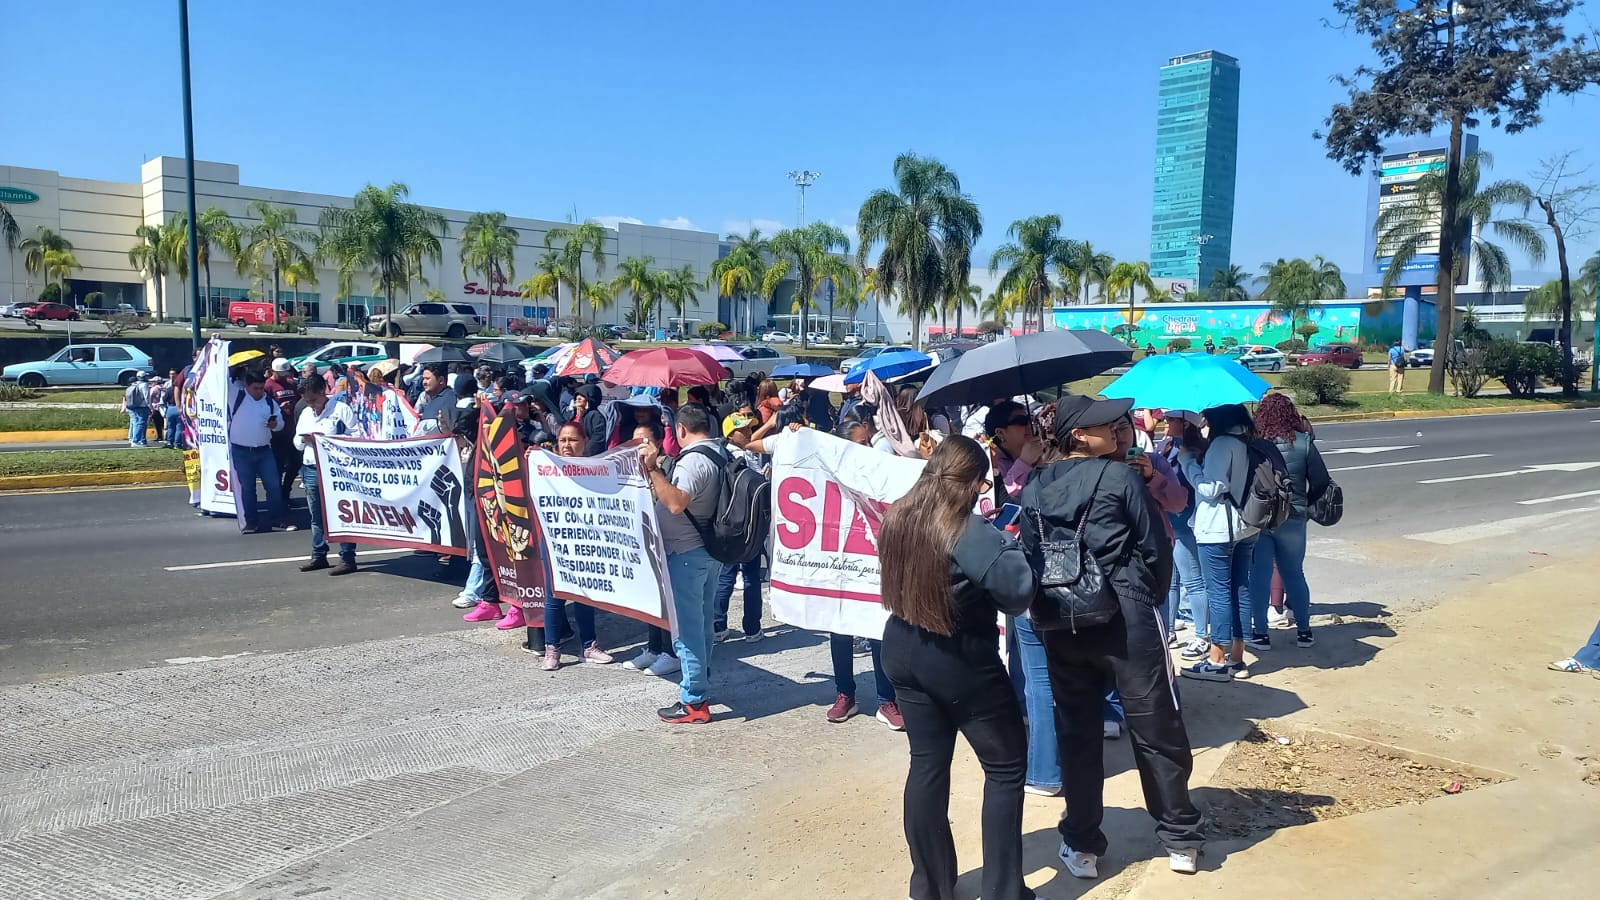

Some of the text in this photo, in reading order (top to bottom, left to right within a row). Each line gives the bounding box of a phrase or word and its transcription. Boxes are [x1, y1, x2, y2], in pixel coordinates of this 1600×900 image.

[407, 460, 422, 471] LOS
[383, 474, 399, 485] LOS
[401, 475, 411, 485] VA
[413, 475, 419, 486] A
[584, 513, 594, 526] LA
[575, 544, 620, 560] RESPONDER
[796, 553, 829, 569] haremos
[610, 564, 619, 577] DE
[622, 567, 634, 580] LOS
